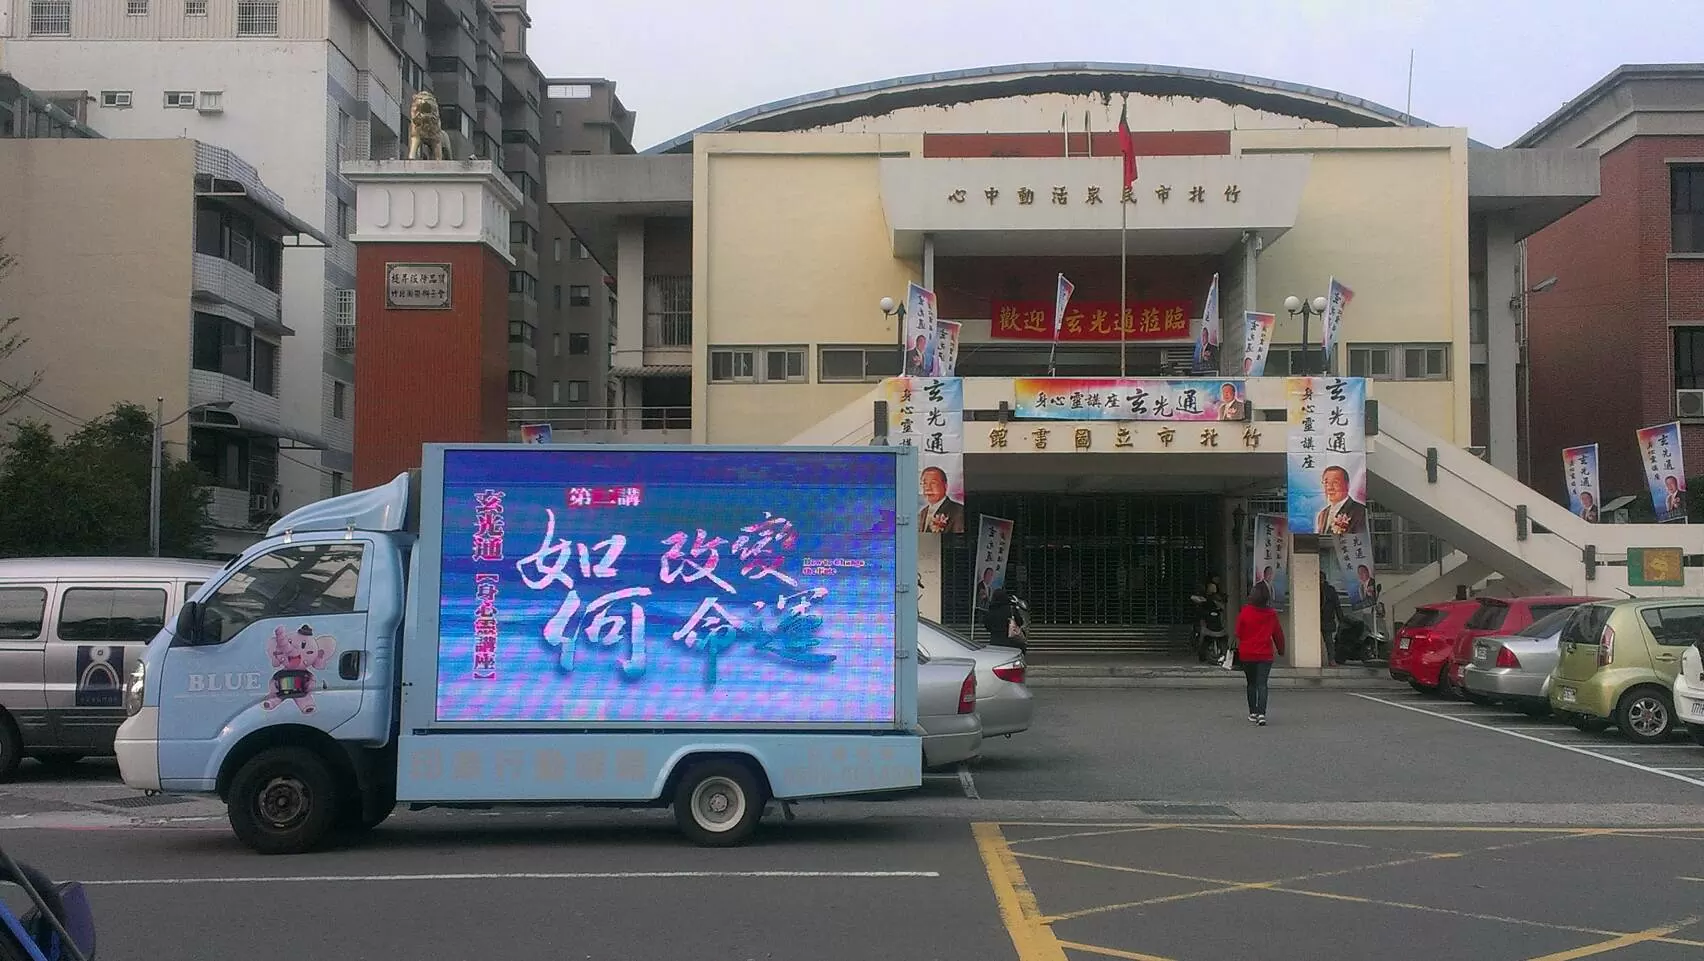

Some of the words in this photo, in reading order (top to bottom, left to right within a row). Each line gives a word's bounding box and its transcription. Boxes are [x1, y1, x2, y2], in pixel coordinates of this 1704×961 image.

[999, 306, 1047, 332] 歡迎
[924, 379, 948, 454] 玄光通
[1300, 387, 1316, 469] 身心靈講座
[1325, 378, 1353, 454] 玄光通
[568, 487, 641, 507] 第二講
[187, 672, 262, 692] BLUE
